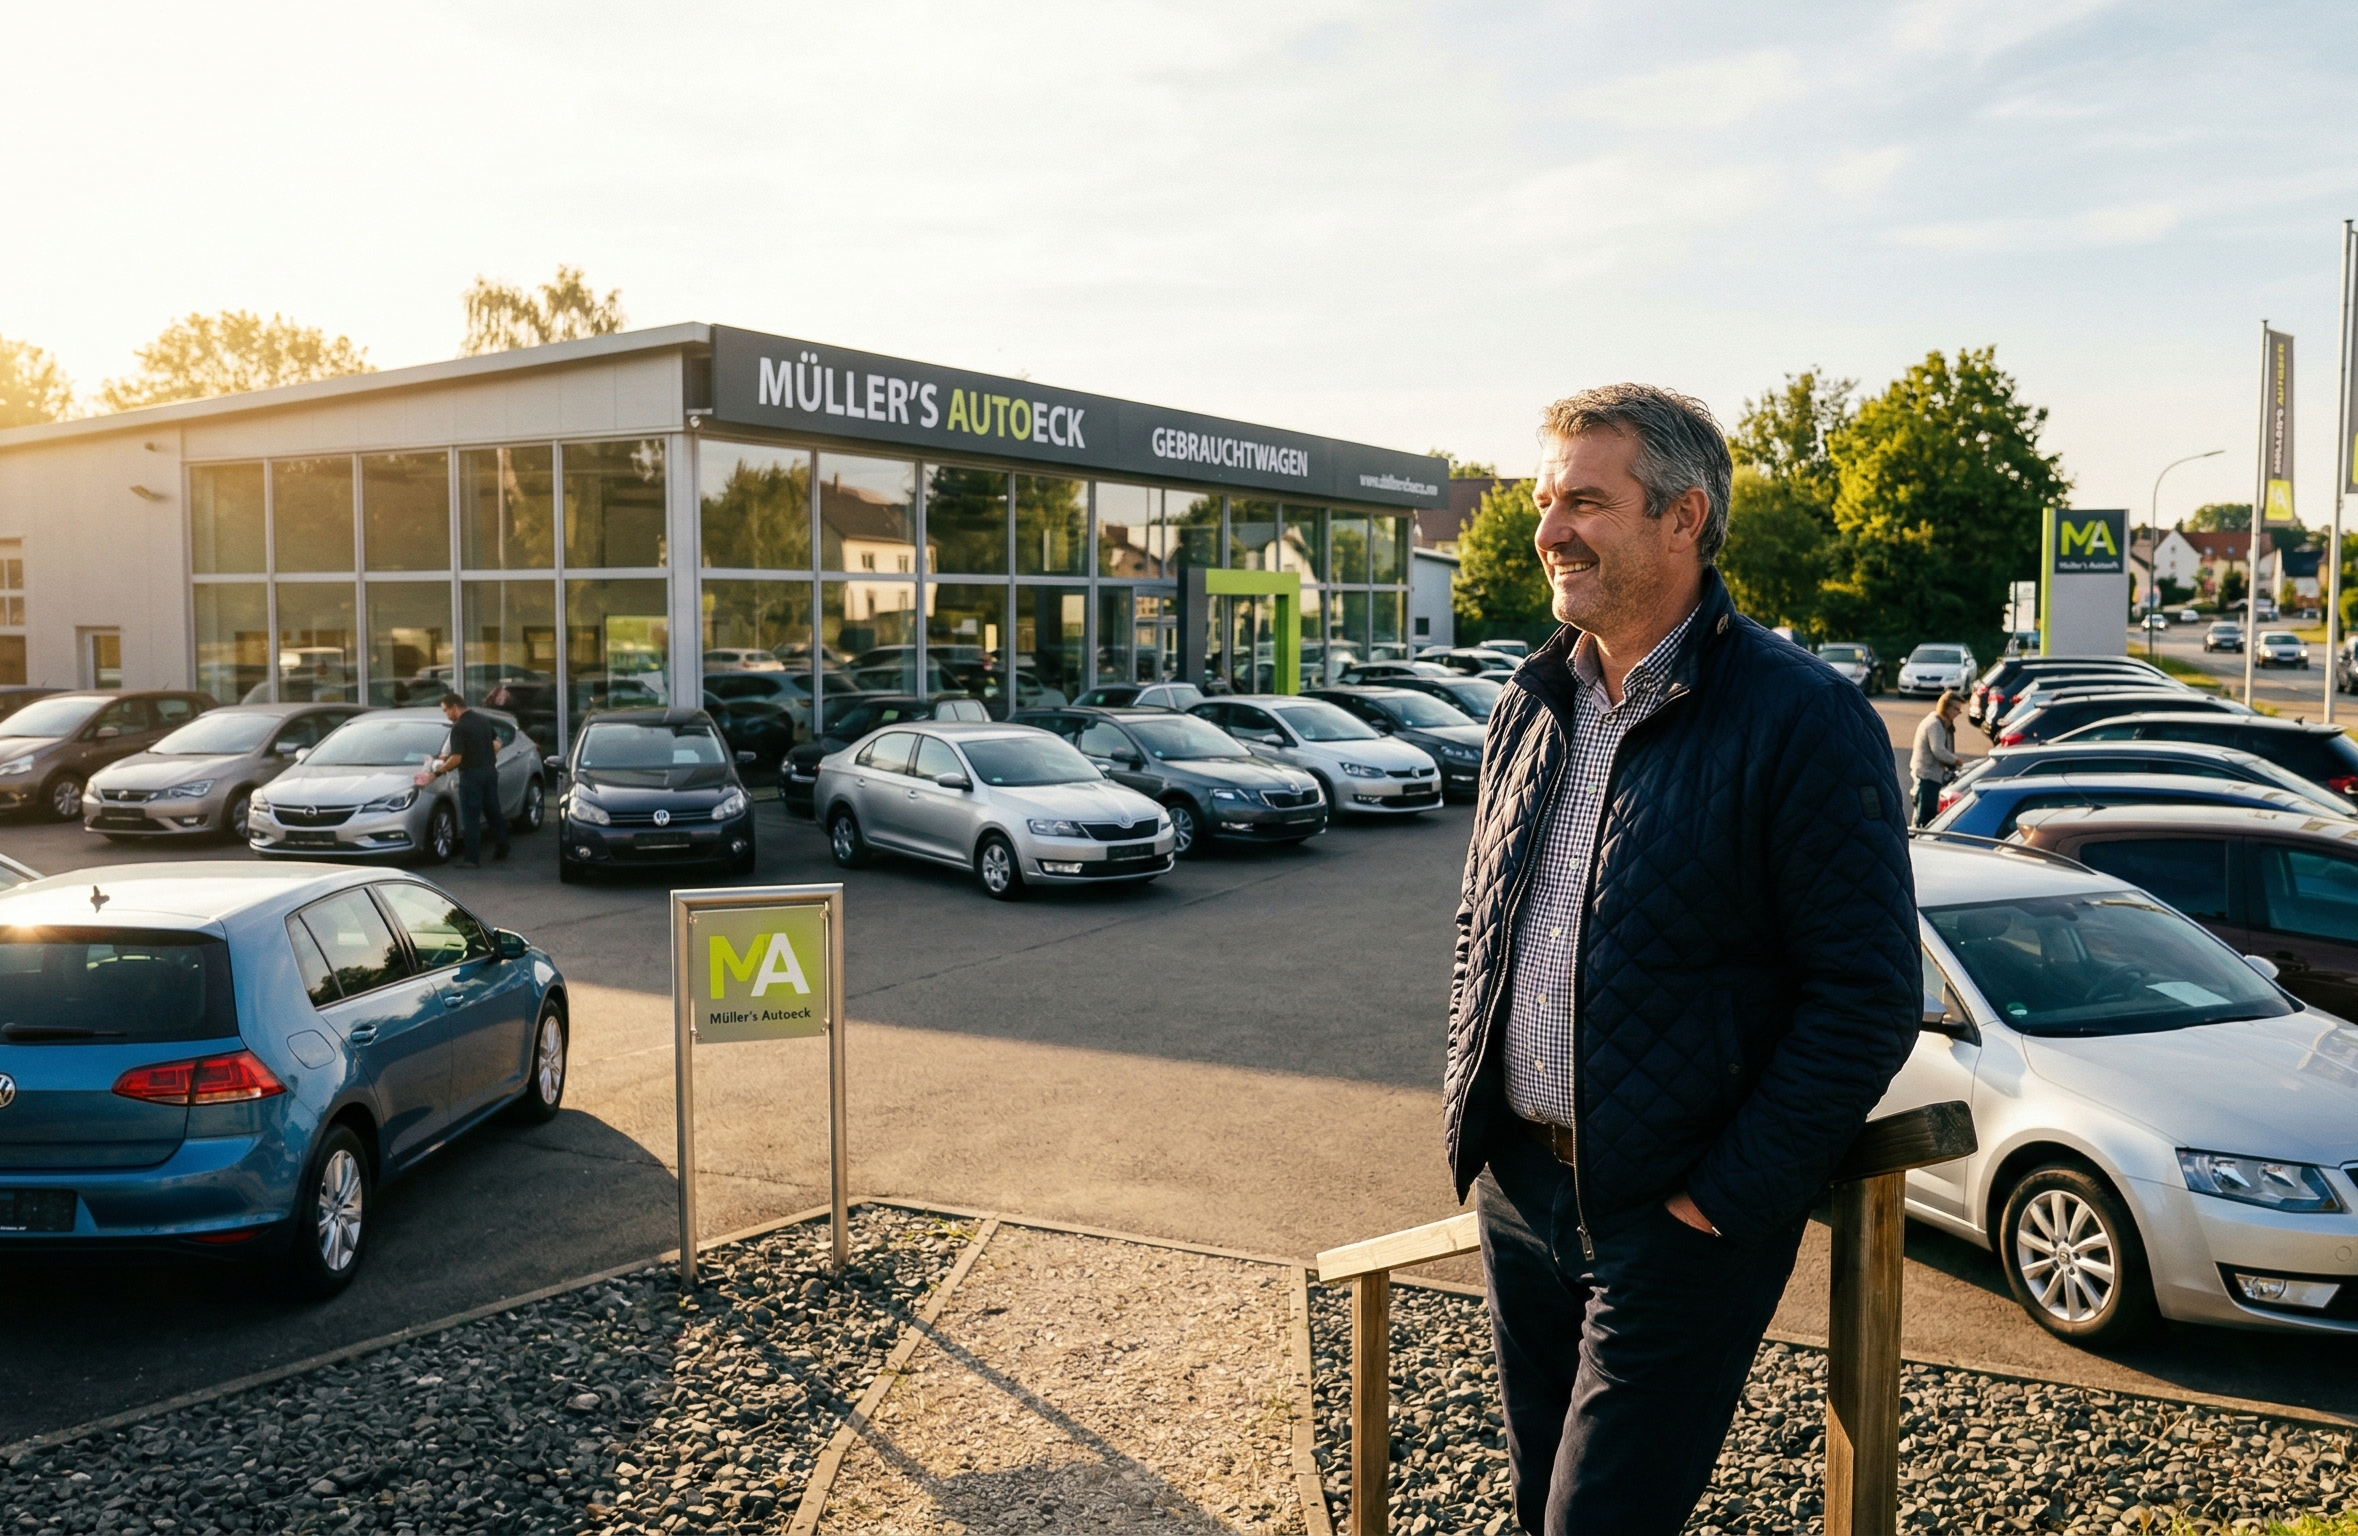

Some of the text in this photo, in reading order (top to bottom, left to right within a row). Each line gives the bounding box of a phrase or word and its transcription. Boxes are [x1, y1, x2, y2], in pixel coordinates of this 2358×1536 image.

[759, 351, 1086, 449] MÜLLER'S AUTOECK
[1152, 427, 1308, 477] GEBRAUCHTWAGEN
[2061, 519, 2117, 556] MA
[709, 932, 811, 999] MA
[710, 1007, 811, 1024] Müller's Autoeck
